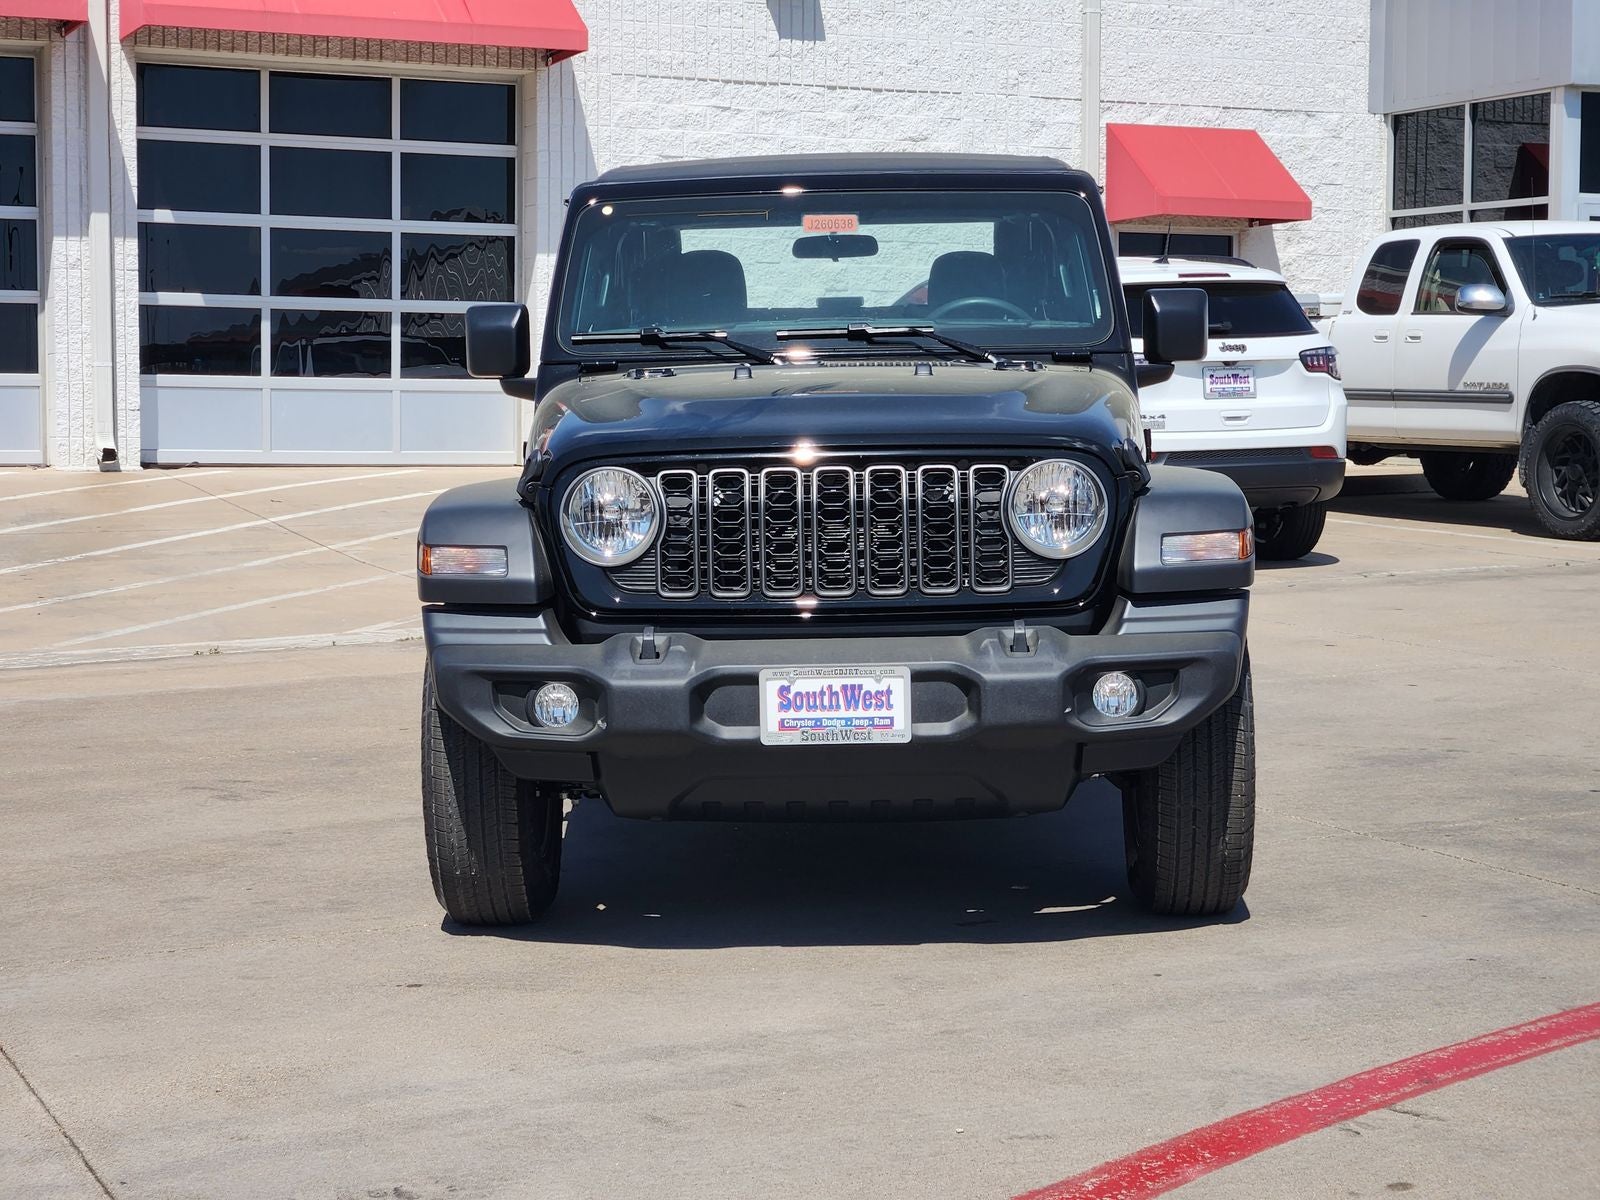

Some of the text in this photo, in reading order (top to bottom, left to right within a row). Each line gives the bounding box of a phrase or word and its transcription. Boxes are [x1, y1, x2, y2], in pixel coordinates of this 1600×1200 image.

[807, 218, 854, 230] J260638
[1219, 342, 1247, 354] Jeep
[1209, 373, 1250, 385] SouthWest
[777, 684, 894, 712] SouthWest
[784, 717, 891, 728] Chrysler Dodge Jeep Ram
[801, 729, 873, 742] SouthWest
